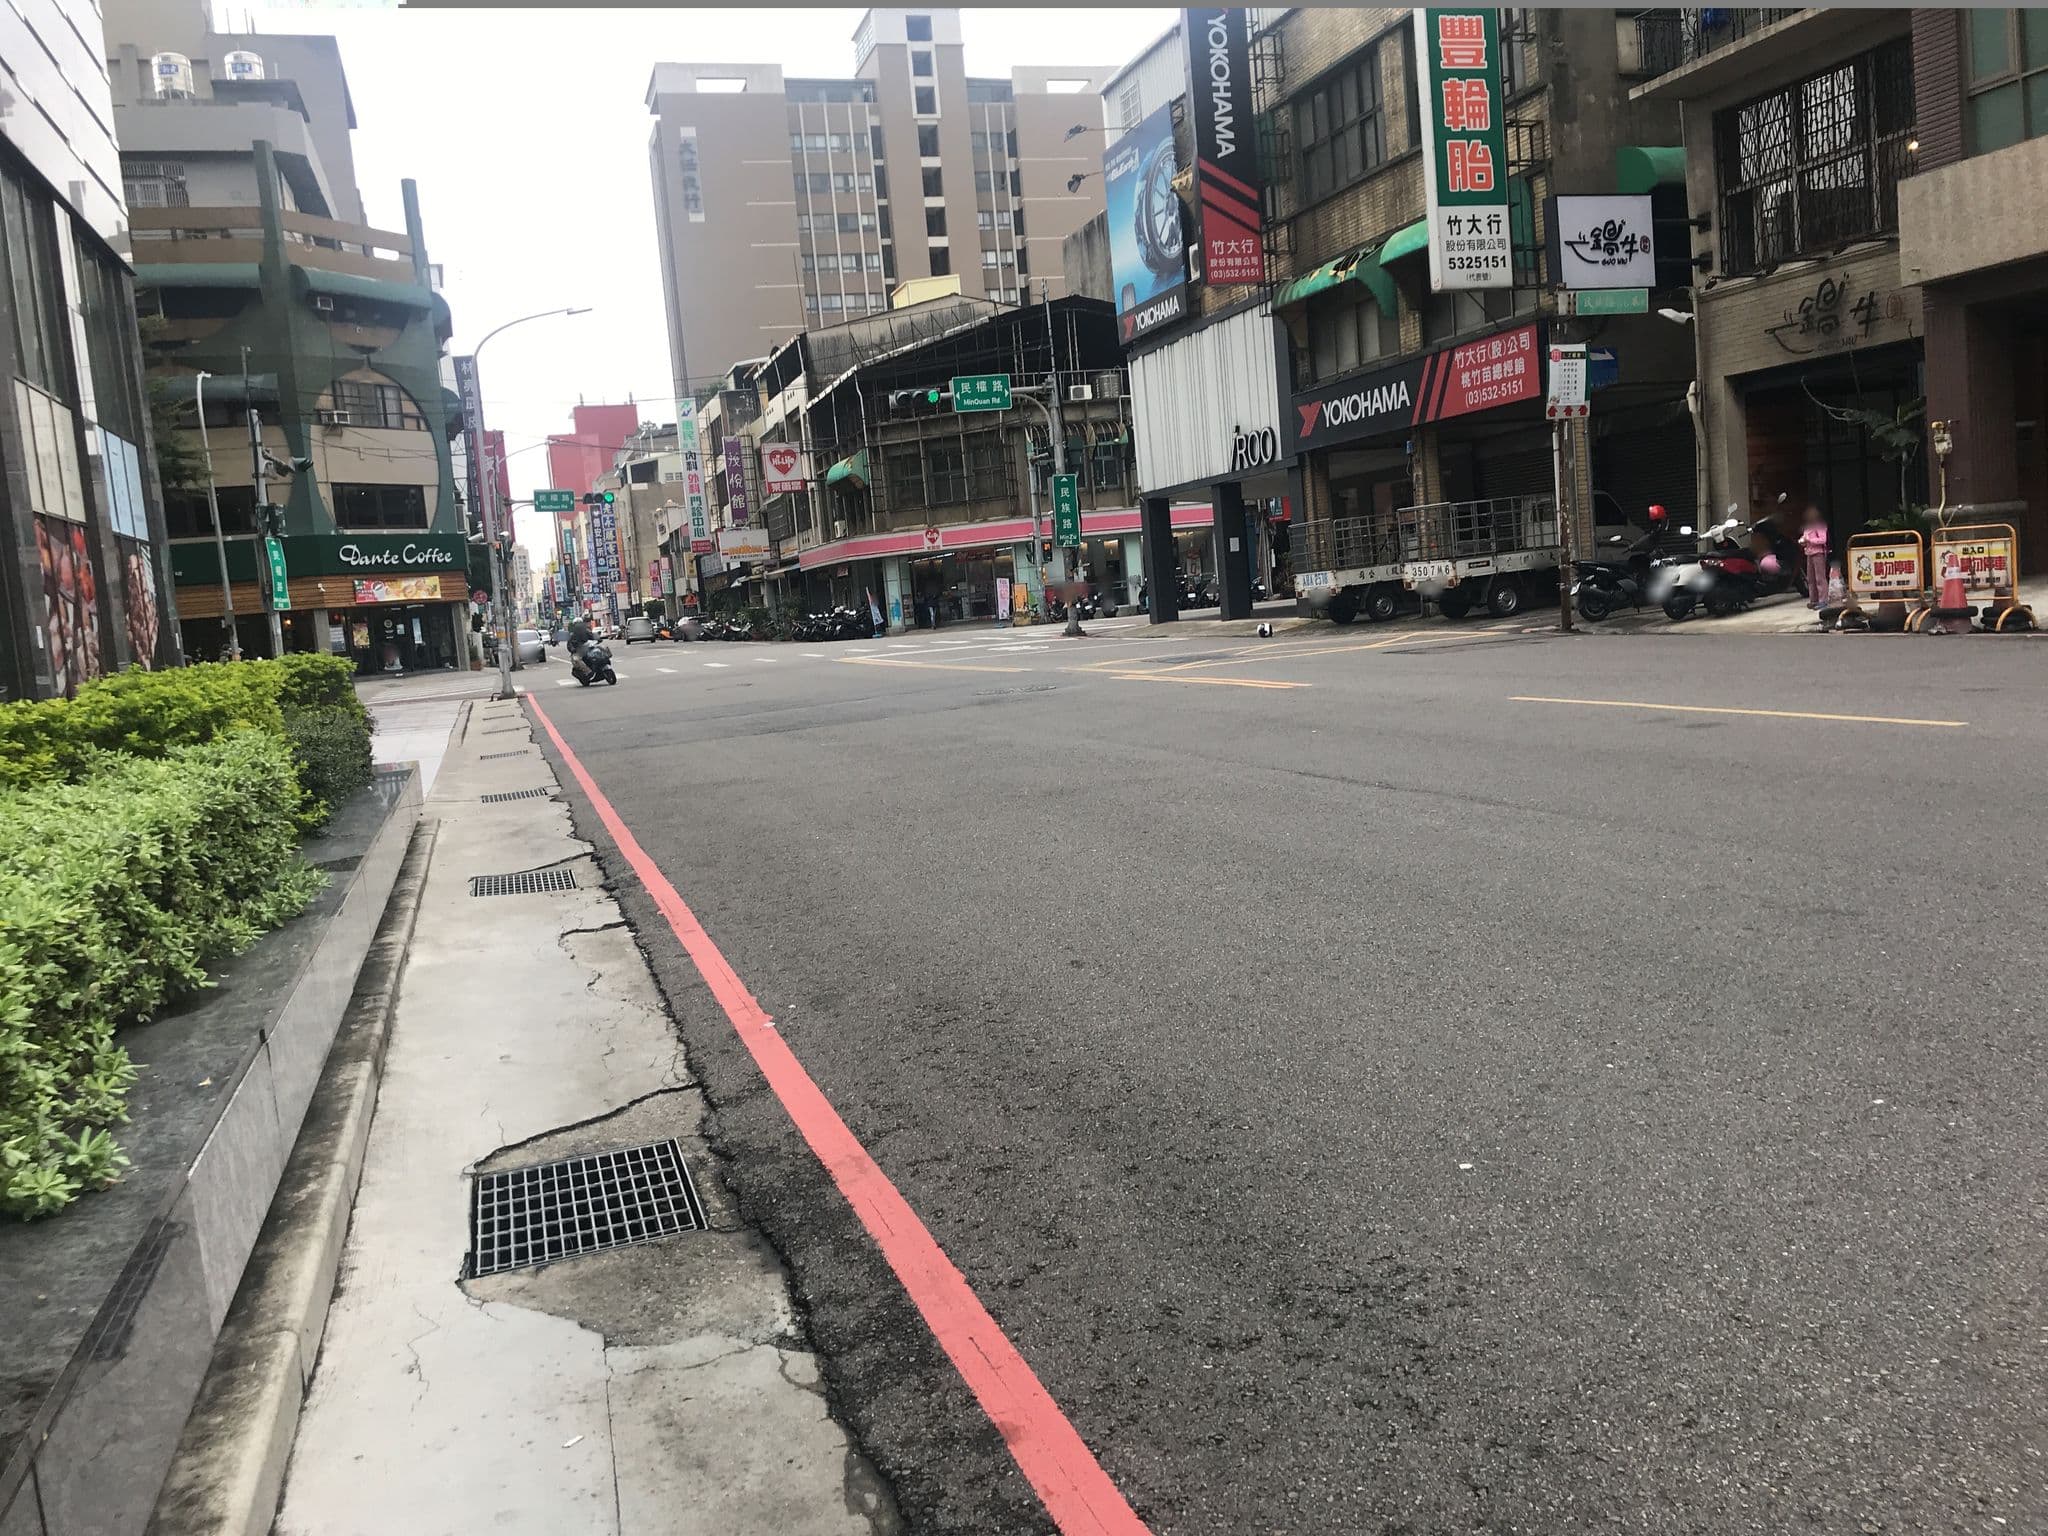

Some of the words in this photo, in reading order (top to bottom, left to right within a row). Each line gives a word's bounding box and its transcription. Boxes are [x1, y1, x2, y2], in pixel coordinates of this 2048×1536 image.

[1207, 14, 1236, 159] YOKOHAMA
[1439, 15, 1494, 191] 豐輪胎
[1447, 214, 1502, 236] 竹大行
[1212, 239, 1254, 255] 竹大行
[1446, 238, 1507, 252] 股份有限公司
[1448, 255, 1507, 270] 5325151
[1135, 294, 1180, 331] YOKOHAMA
[1455, 332, 1530, 369] 竹大行(股)公司
[961, 380, 1003, 394] 民權路
[1465, 379, 1524, 408] (03)532-5151
[1322, 380, 1411, 428] YOKOHAMA
[688, 473, 700, 494] 外科
[690, 495, 706, 538] 門診中心
[1060, 487, 1072, 529] 民族路
[340, 544, 399, 566] Dante
[402, 544, 452, 564] Coffee
